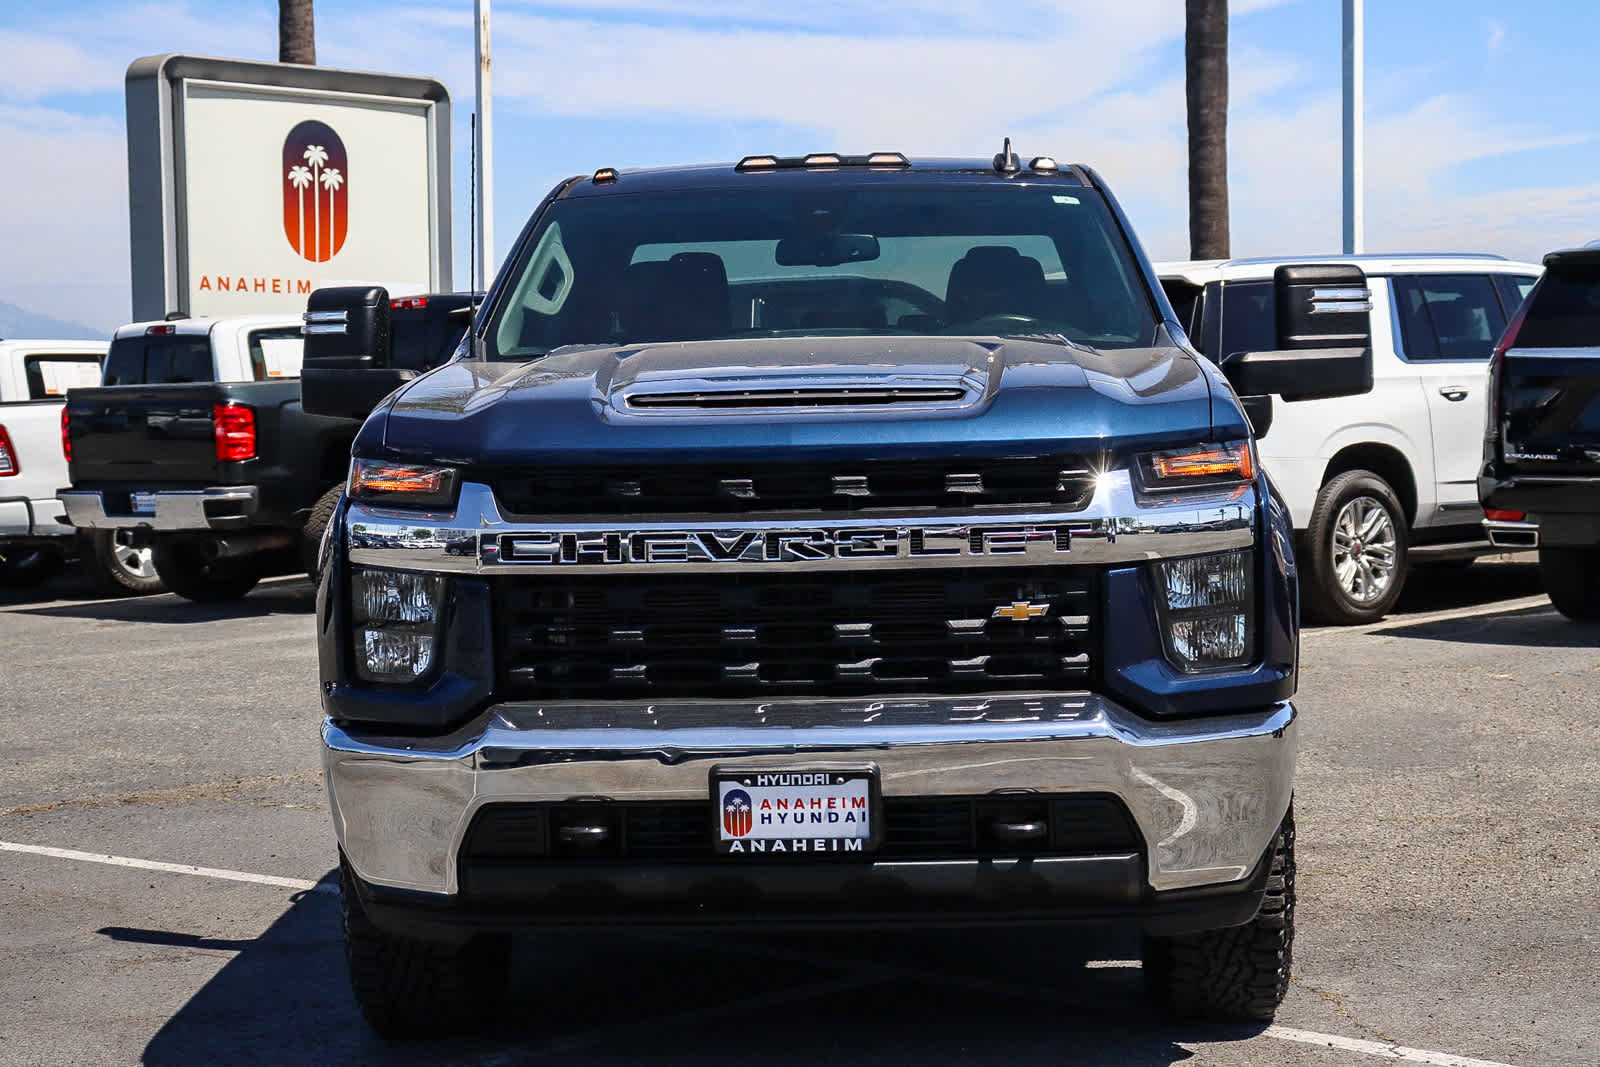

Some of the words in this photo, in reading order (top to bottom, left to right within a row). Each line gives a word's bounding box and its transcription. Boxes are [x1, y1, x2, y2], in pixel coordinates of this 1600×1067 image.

[199, 275, 311, 294] ANAHEIM
[496, 522, 1093, 564] CHEVROLET
[757, 773, 830, 786] HYUNDAI
[760, 796, 866, 810] ANAHEIM
[760, 811, 866, 824] HYUNDAI
[729, 838, 863, 853] ANAHEIM
